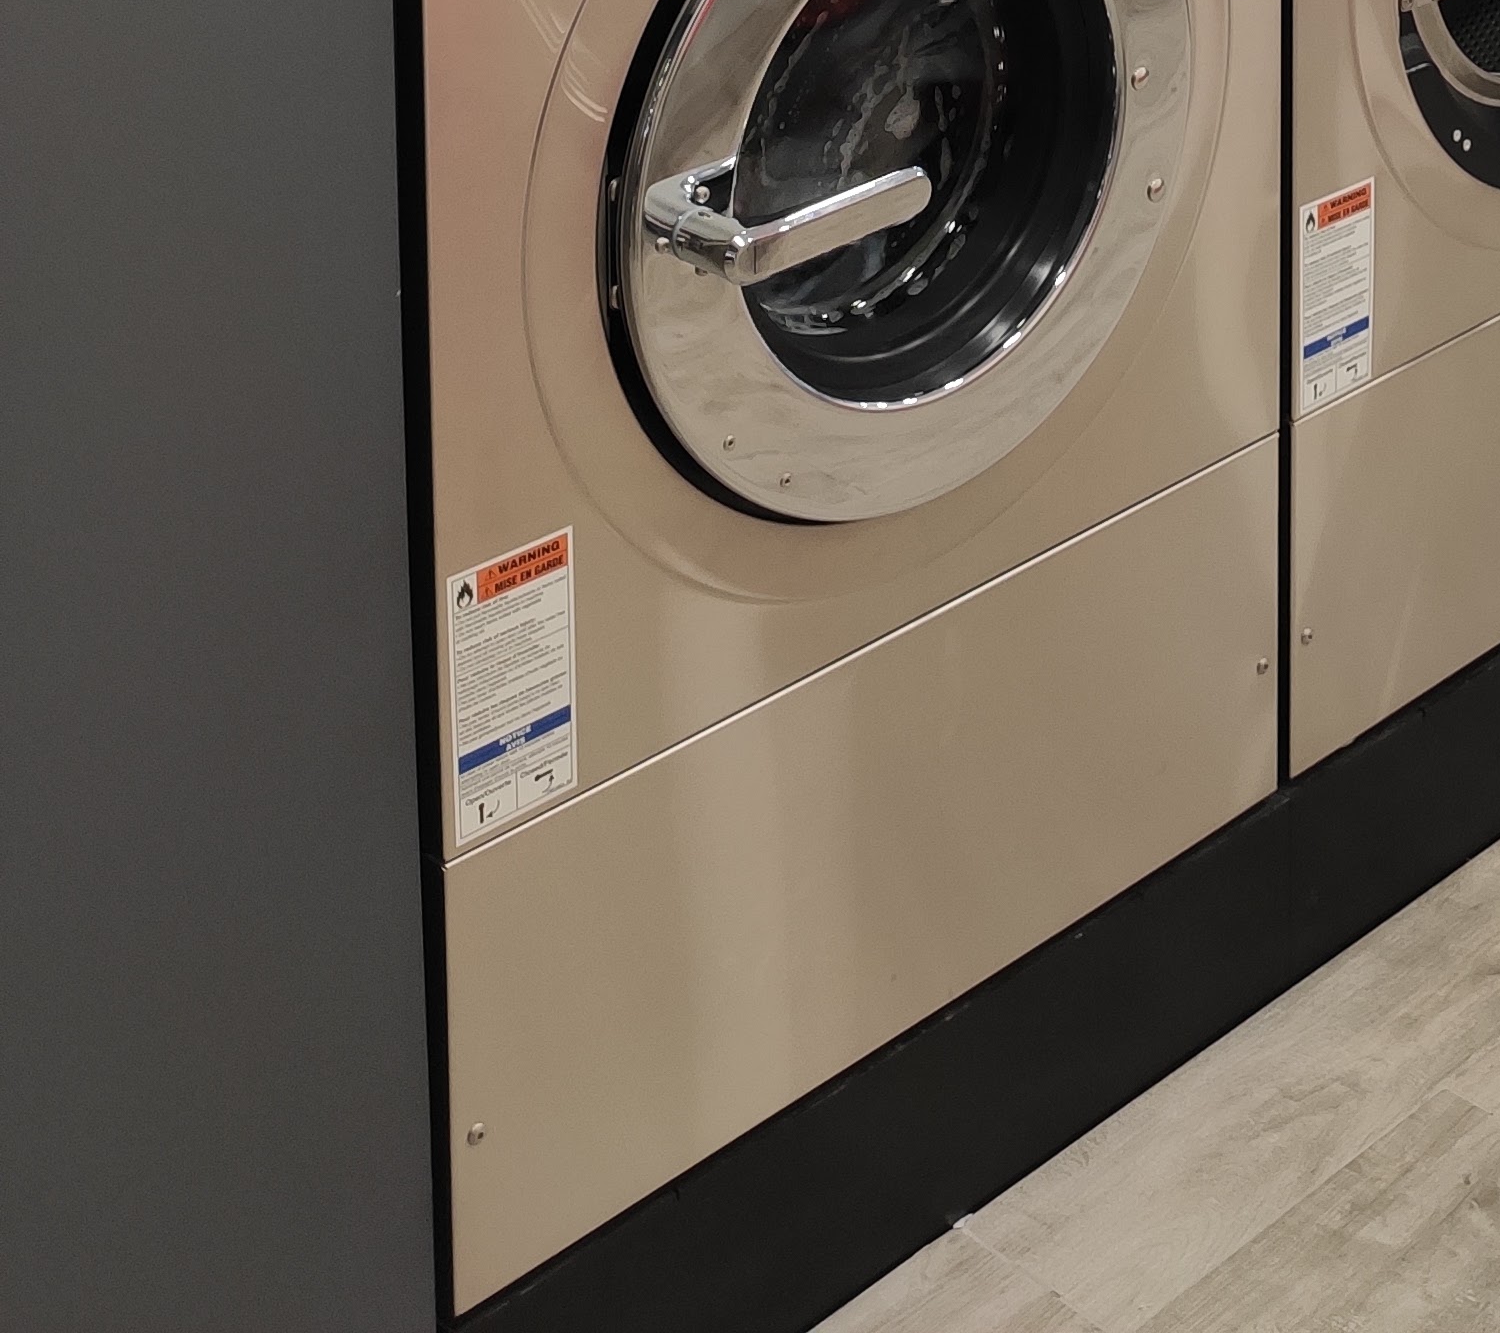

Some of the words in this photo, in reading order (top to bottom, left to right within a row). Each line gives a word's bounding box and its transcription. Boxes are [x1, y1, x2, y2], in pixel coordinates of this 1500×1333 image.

[494, 574, 518, 594] MISE
[520, 568, 532, 582] EN
[534, 554, 564, 576] GARDE
[498, 540, 560, 574] WARNING
[499, 724, 532, 746] NOTICE
